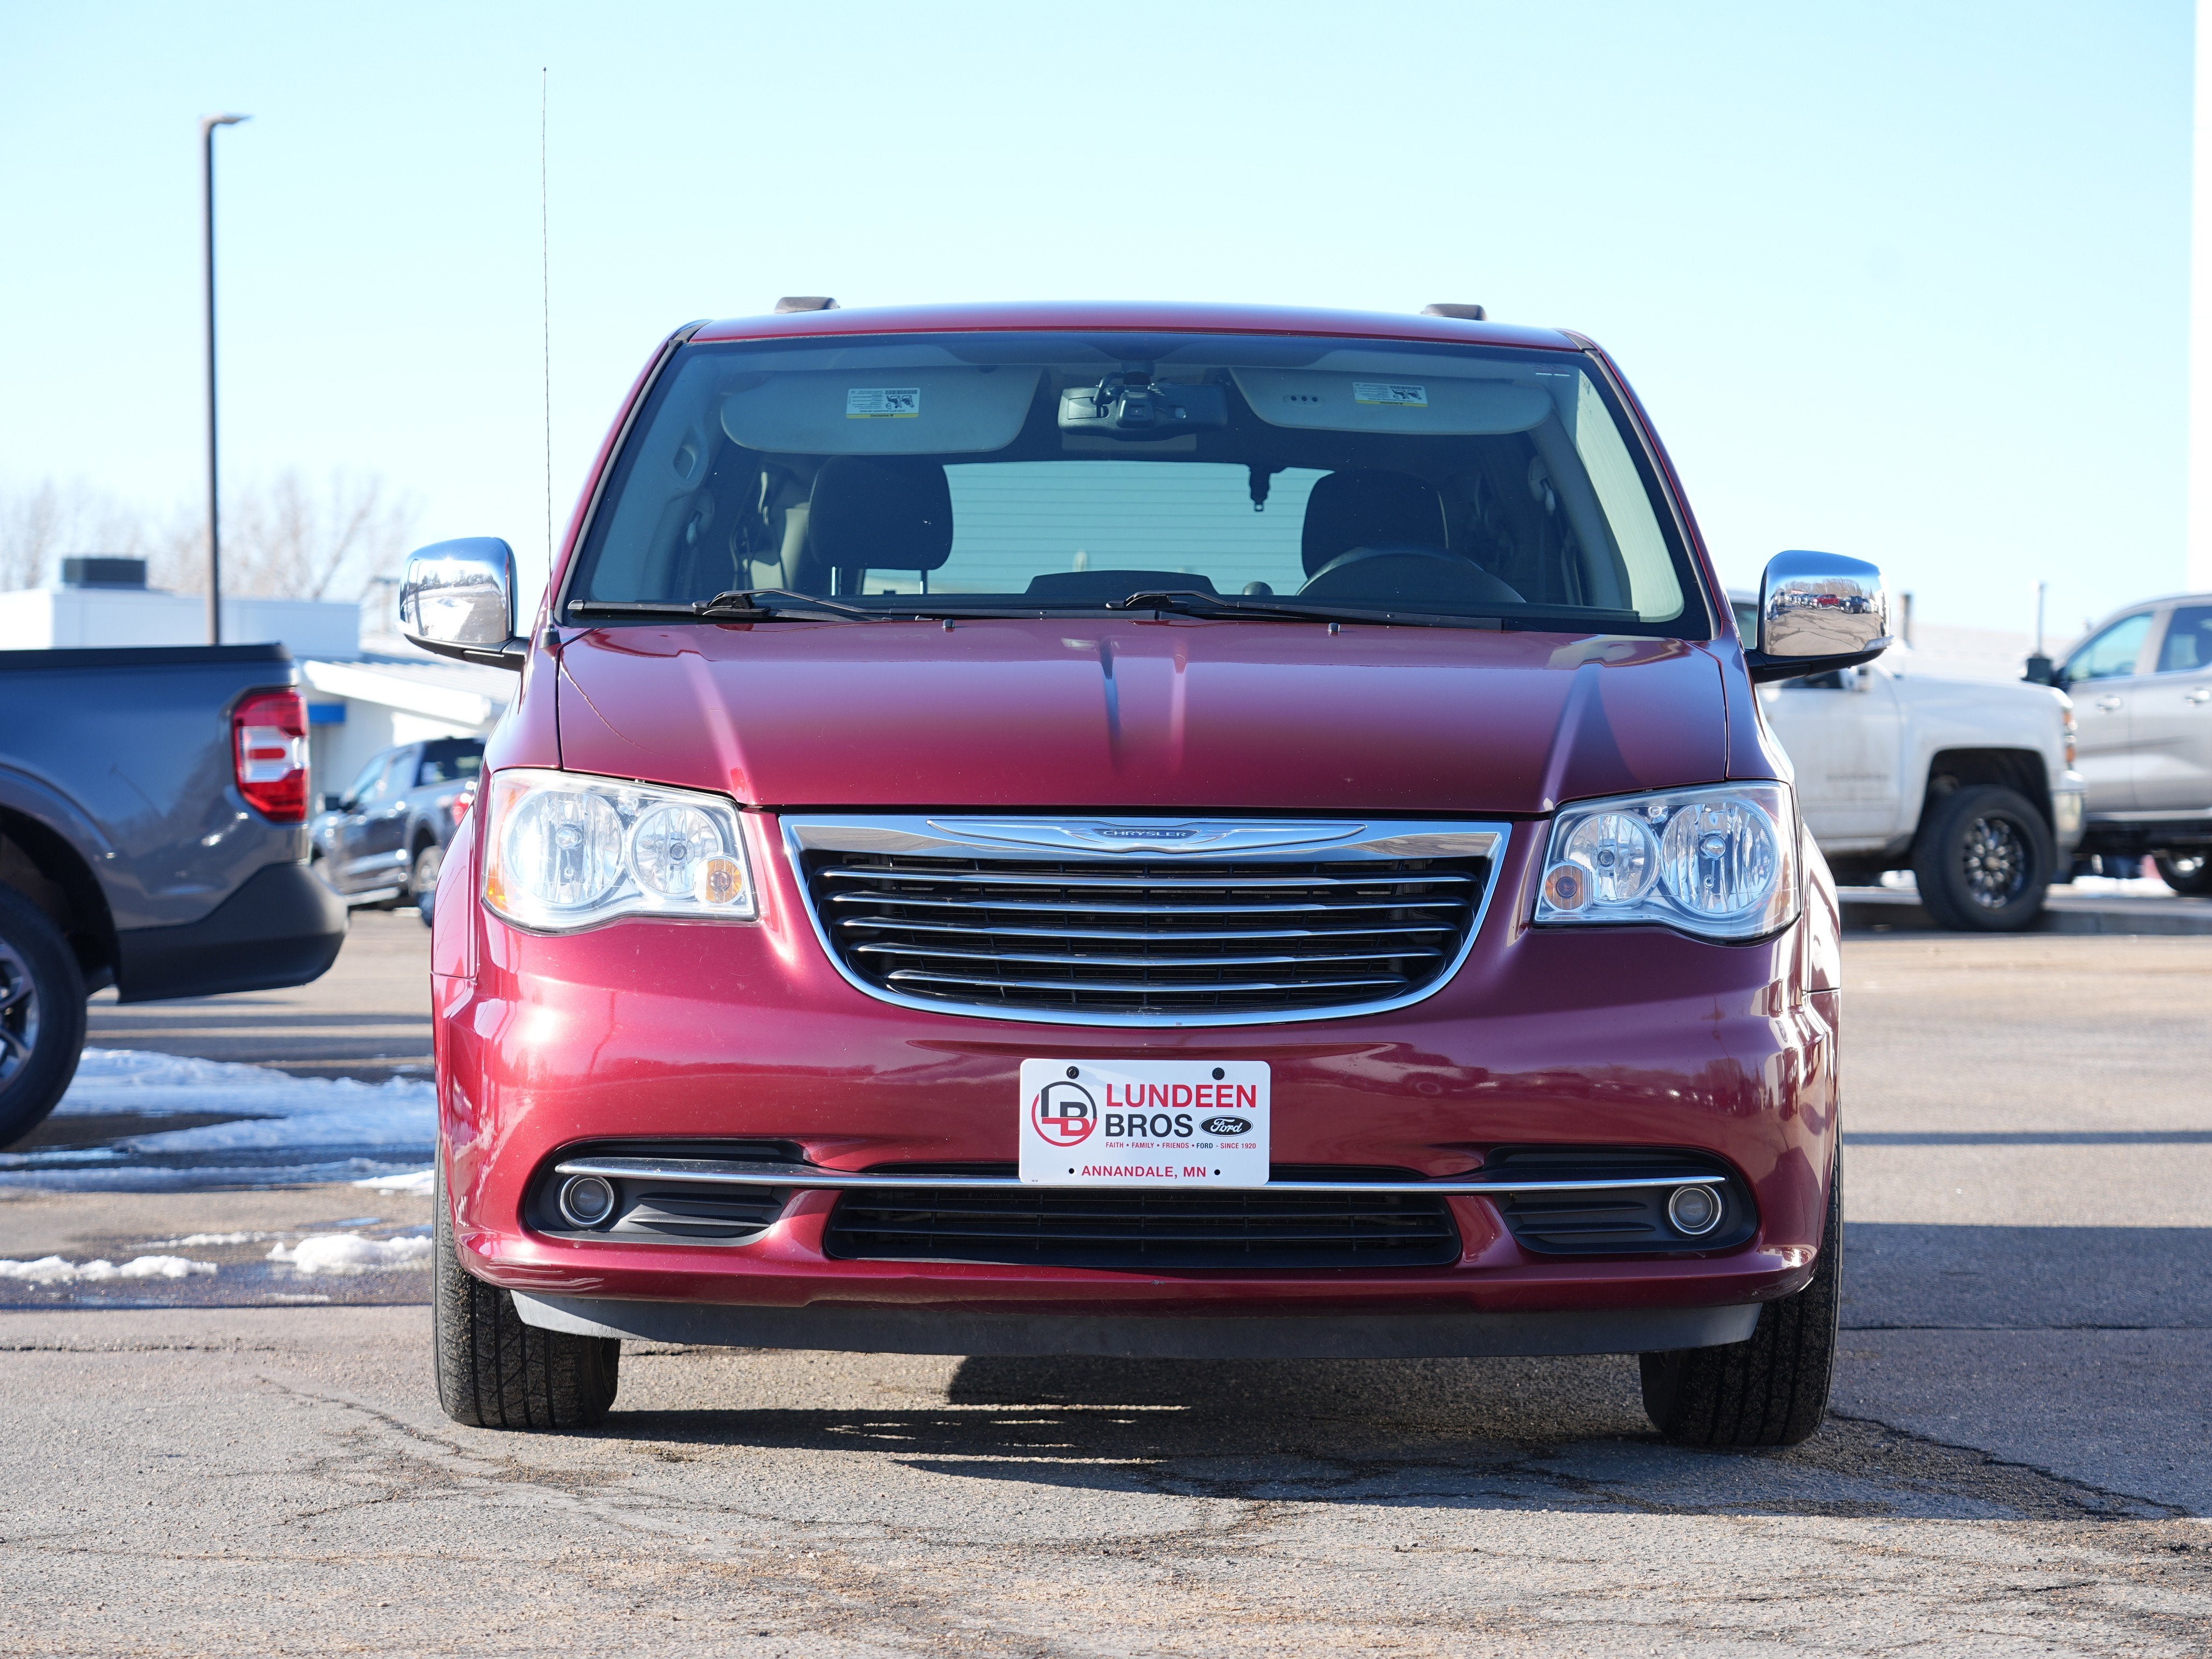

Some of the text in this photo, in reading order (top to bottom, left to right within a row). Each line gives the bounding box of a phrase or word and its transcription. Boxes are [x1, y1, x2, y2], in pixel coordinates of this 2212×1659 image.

[1107, 1084, 1256, 1108] LUNDEEN
[1105, 1114, 1193, 1138] BROS
[1210, 1118, 1243, 1132] Ford
[1081, 1165, 1206, 1179] ANNANDALE, MN
